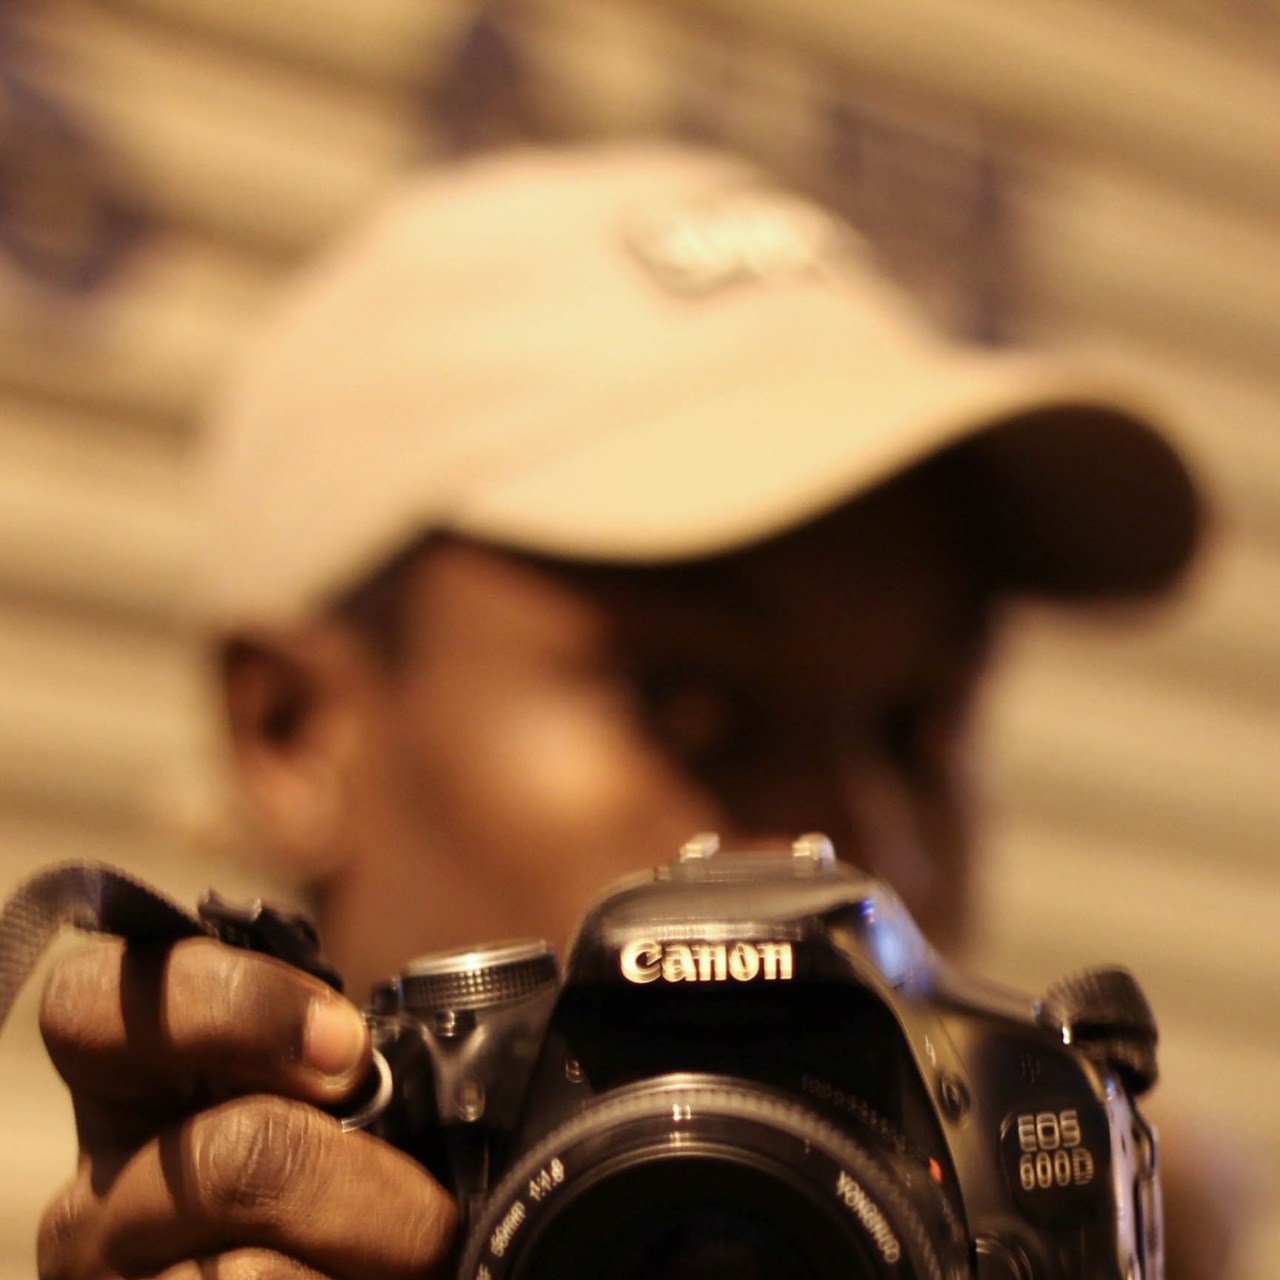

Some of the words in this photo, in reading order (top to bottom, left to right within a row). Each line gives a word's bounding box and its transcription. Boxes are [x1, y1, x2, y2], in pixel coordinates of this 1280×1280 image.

[621, 938, 792, 984] Canon
[1018, 1109, 1081, 1152] EOS
[1019, 1148, 1094, 1191] 600D
